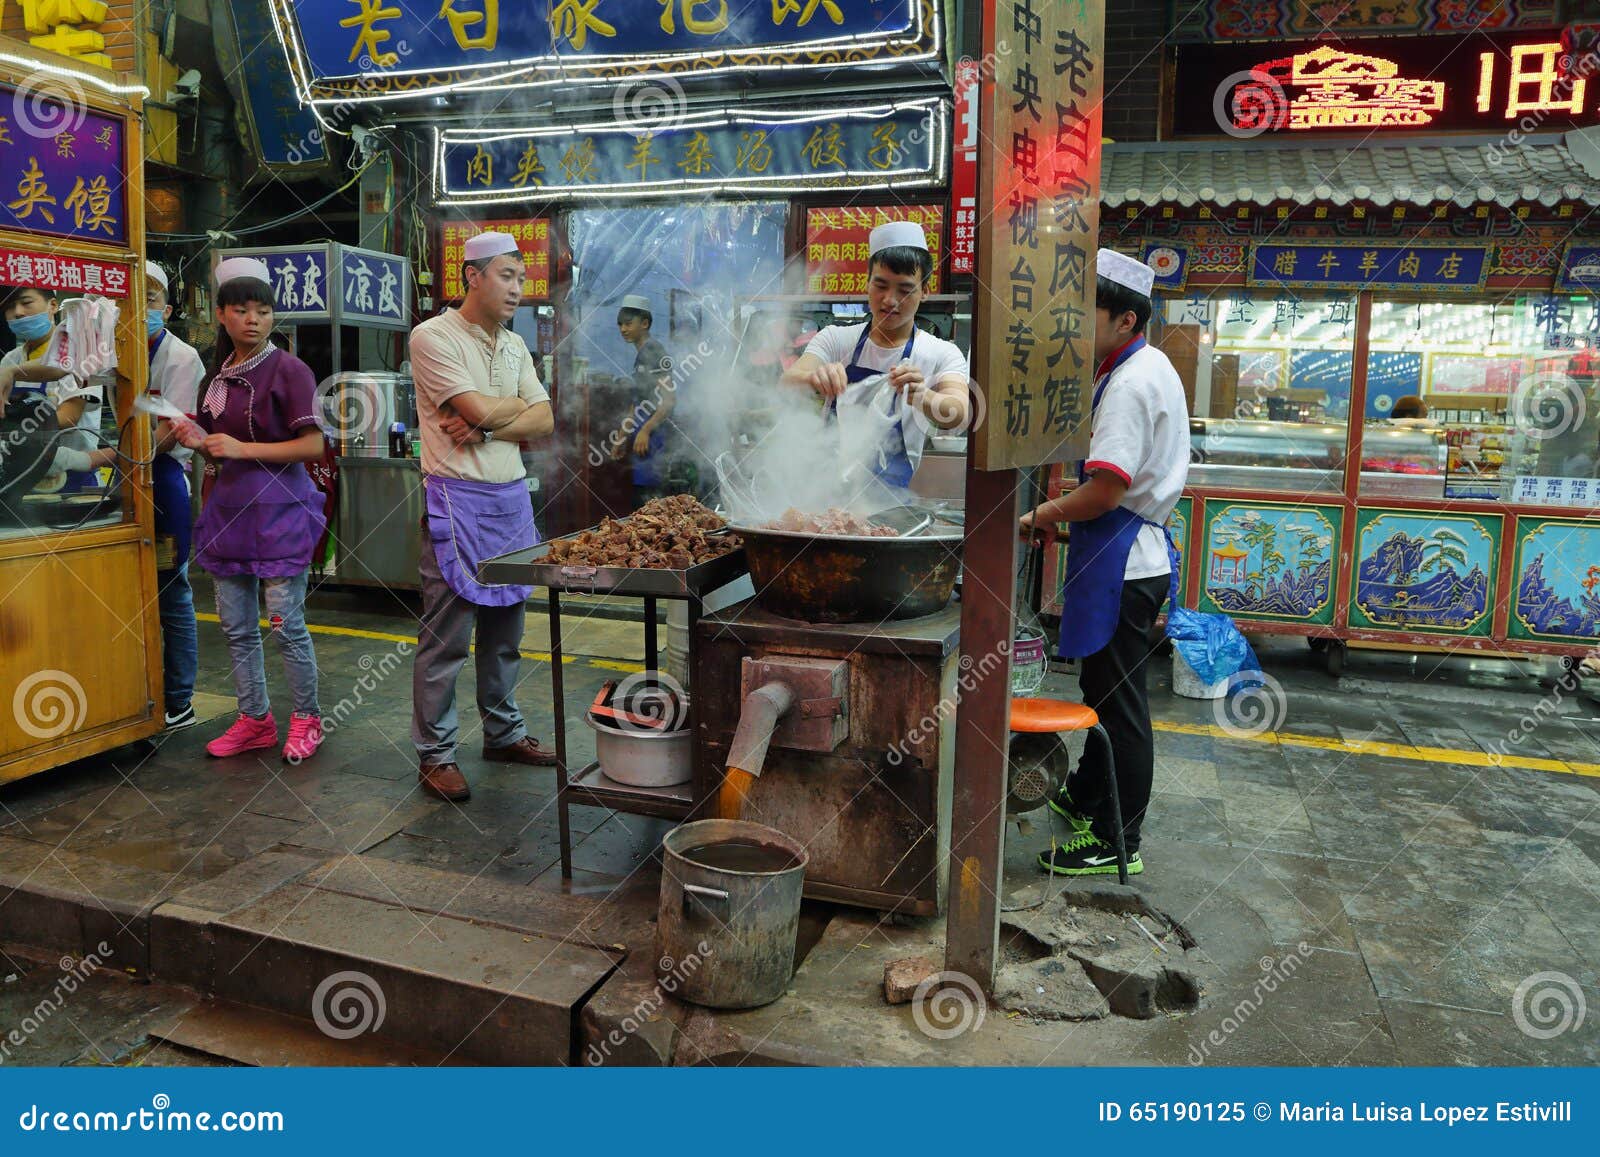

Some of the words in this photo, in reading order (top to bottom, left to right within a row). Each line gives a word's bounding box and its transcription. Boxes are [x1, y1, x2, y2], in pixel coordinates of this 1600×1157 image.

[8, 156, 117, 236] 夹馍
[1004, 1, 1042, 437] 中央电视台专访
[1042, 28, 1094, 435] 老白家肉夹馍
[0, 253, 126, 294] 馍现抽真空
[255, 254, 326, 310] 凉皮
[345, 259, 401, 318] 凉皮
[1274, 249, 1464, 280] 腊牛羊肉店
